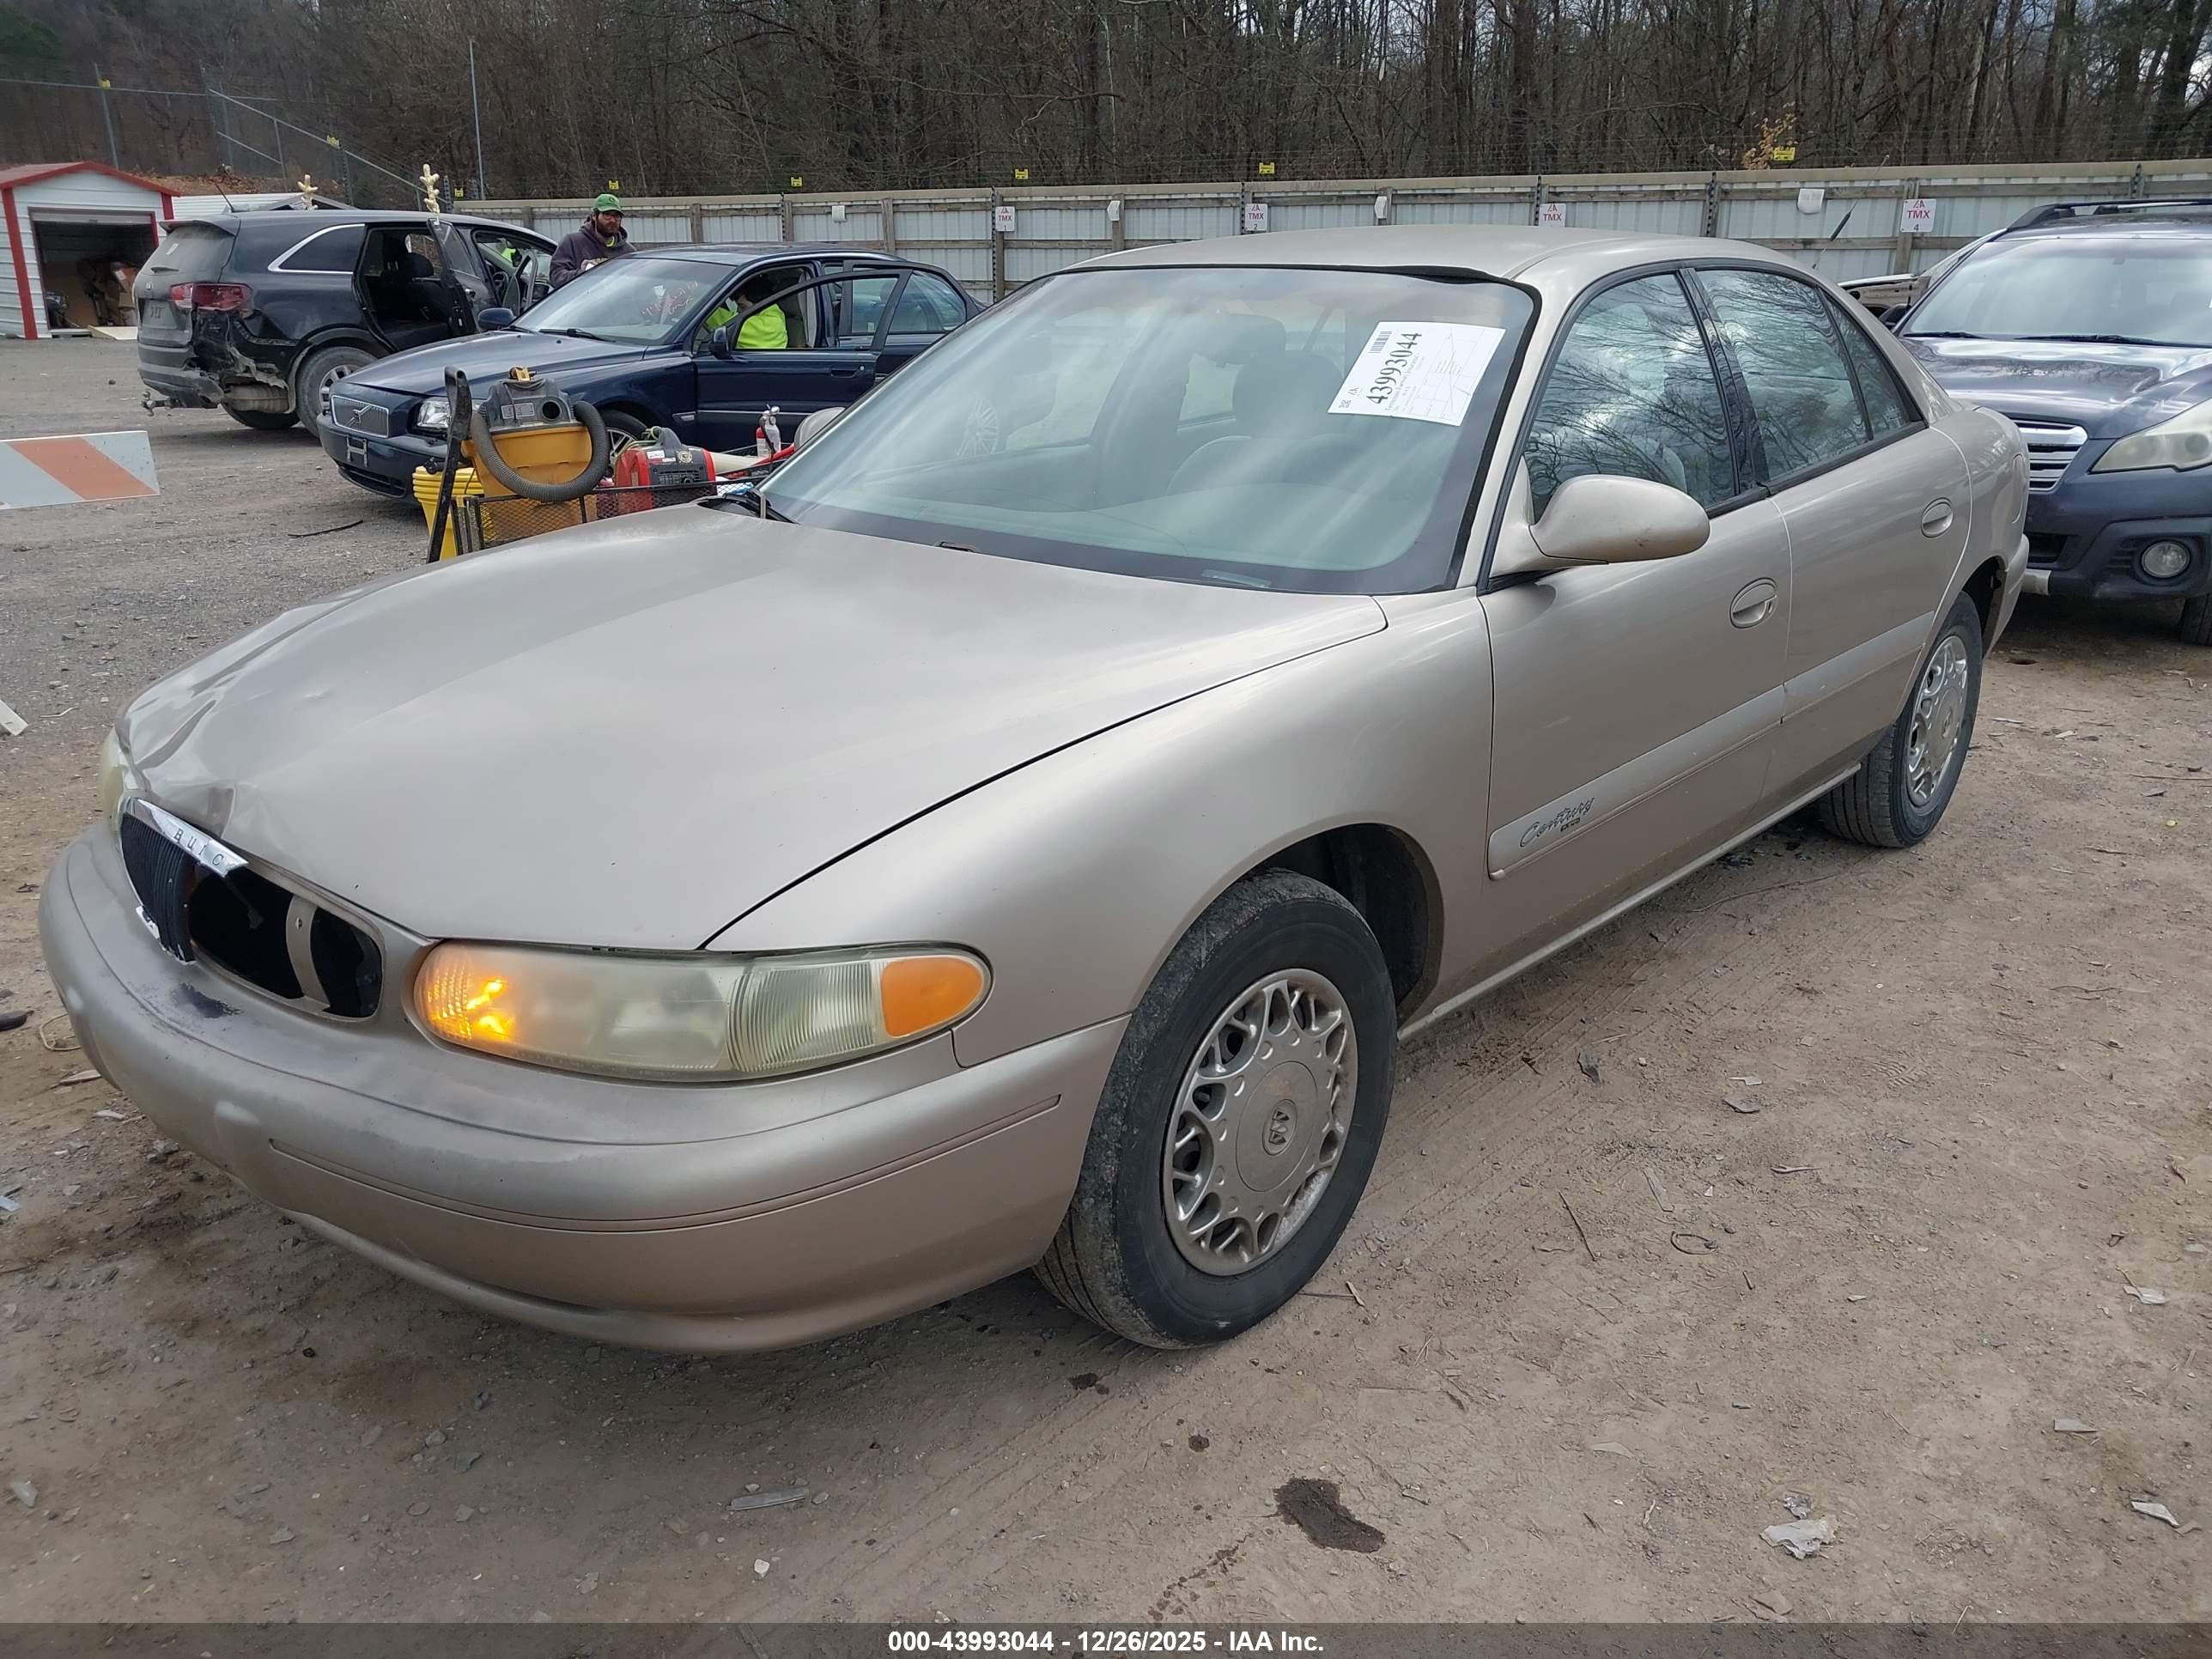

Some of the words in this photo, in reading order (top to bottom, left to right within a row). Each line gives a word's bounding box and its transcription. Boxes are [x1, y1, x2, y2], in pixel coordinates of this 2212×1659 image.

[1906, 210, 1930, 220] TMX
[1366, 332, 1423, 404] 43993044
[1520, 797, 1595, 848] Century
